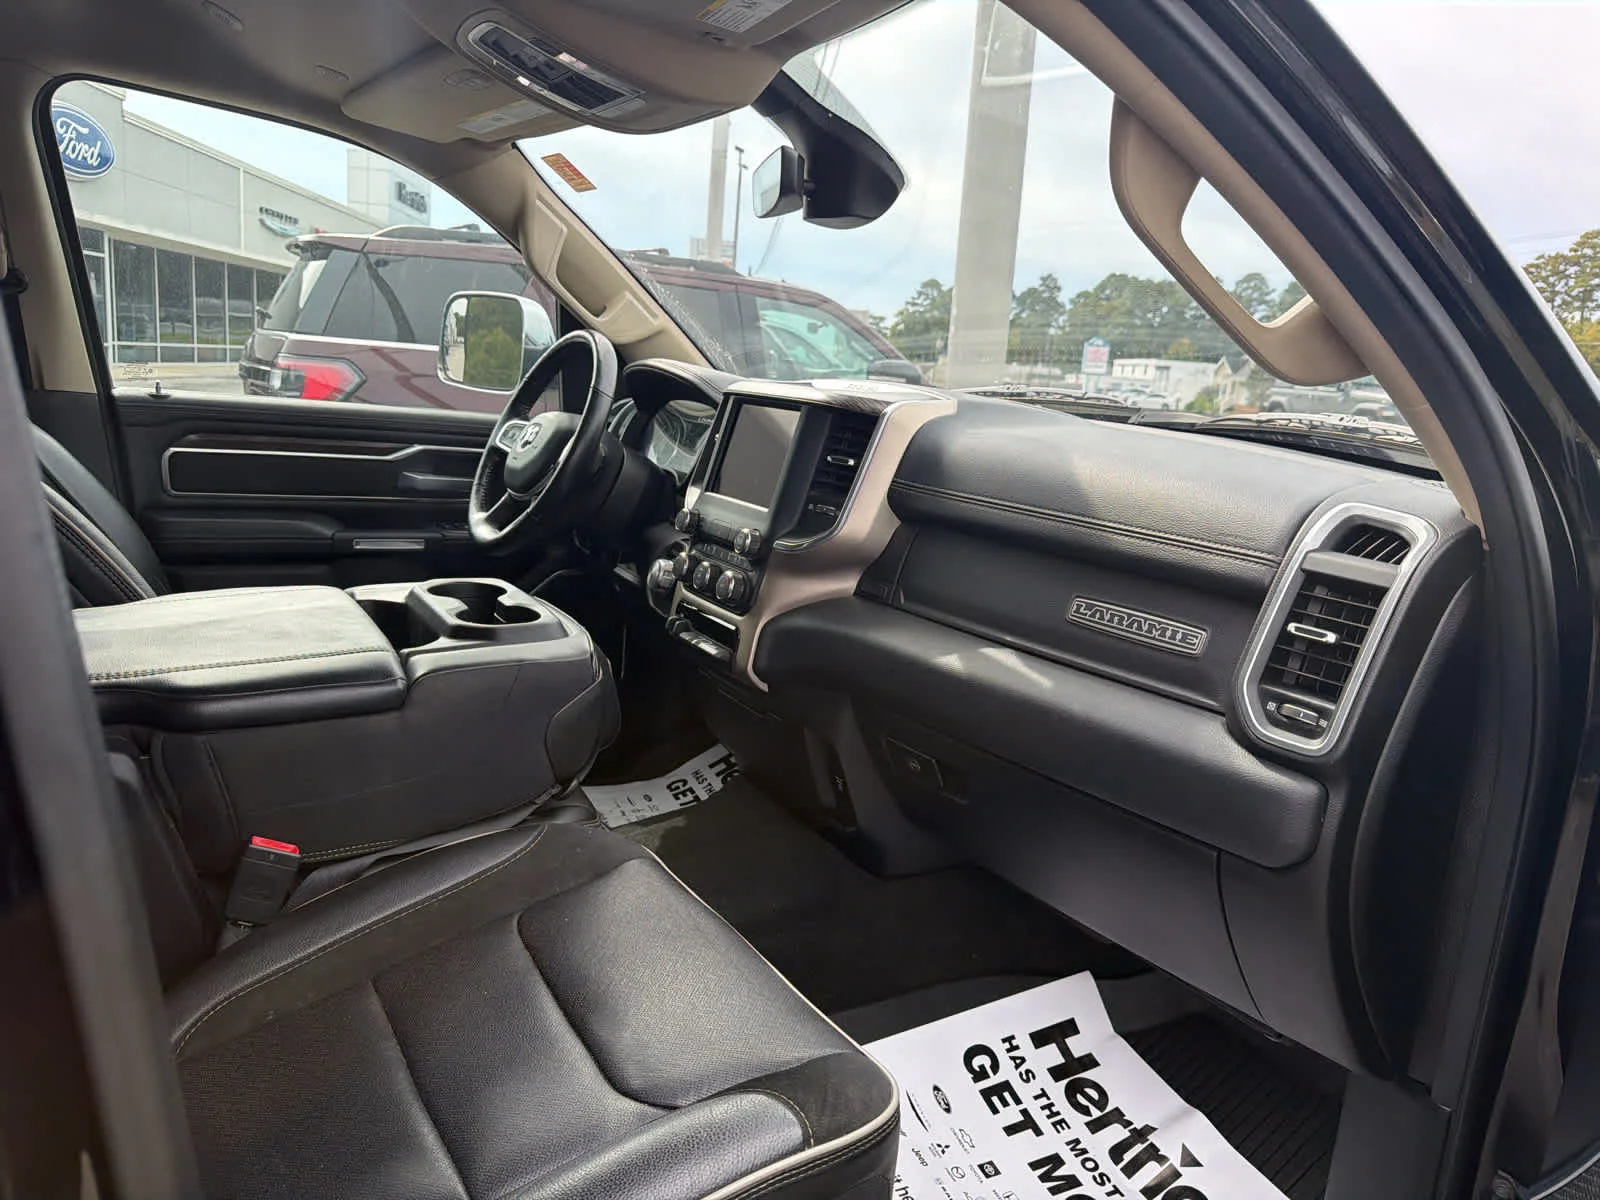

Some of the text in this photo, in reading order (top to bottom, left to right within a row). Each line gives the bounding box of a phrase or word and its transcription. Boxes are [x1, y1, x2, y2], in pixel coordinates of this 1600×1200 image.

[56, 117, 102, 166] Ford
[1072, 602, 1200, 648] LARAMIE
[666, 778, 701, 807] GET
[963, 1043, 1097, 1200] GET M
[1001, 1034, 1125, 1198] HAS THE MOST
[911, 1147, 928, 1167] Jeep
